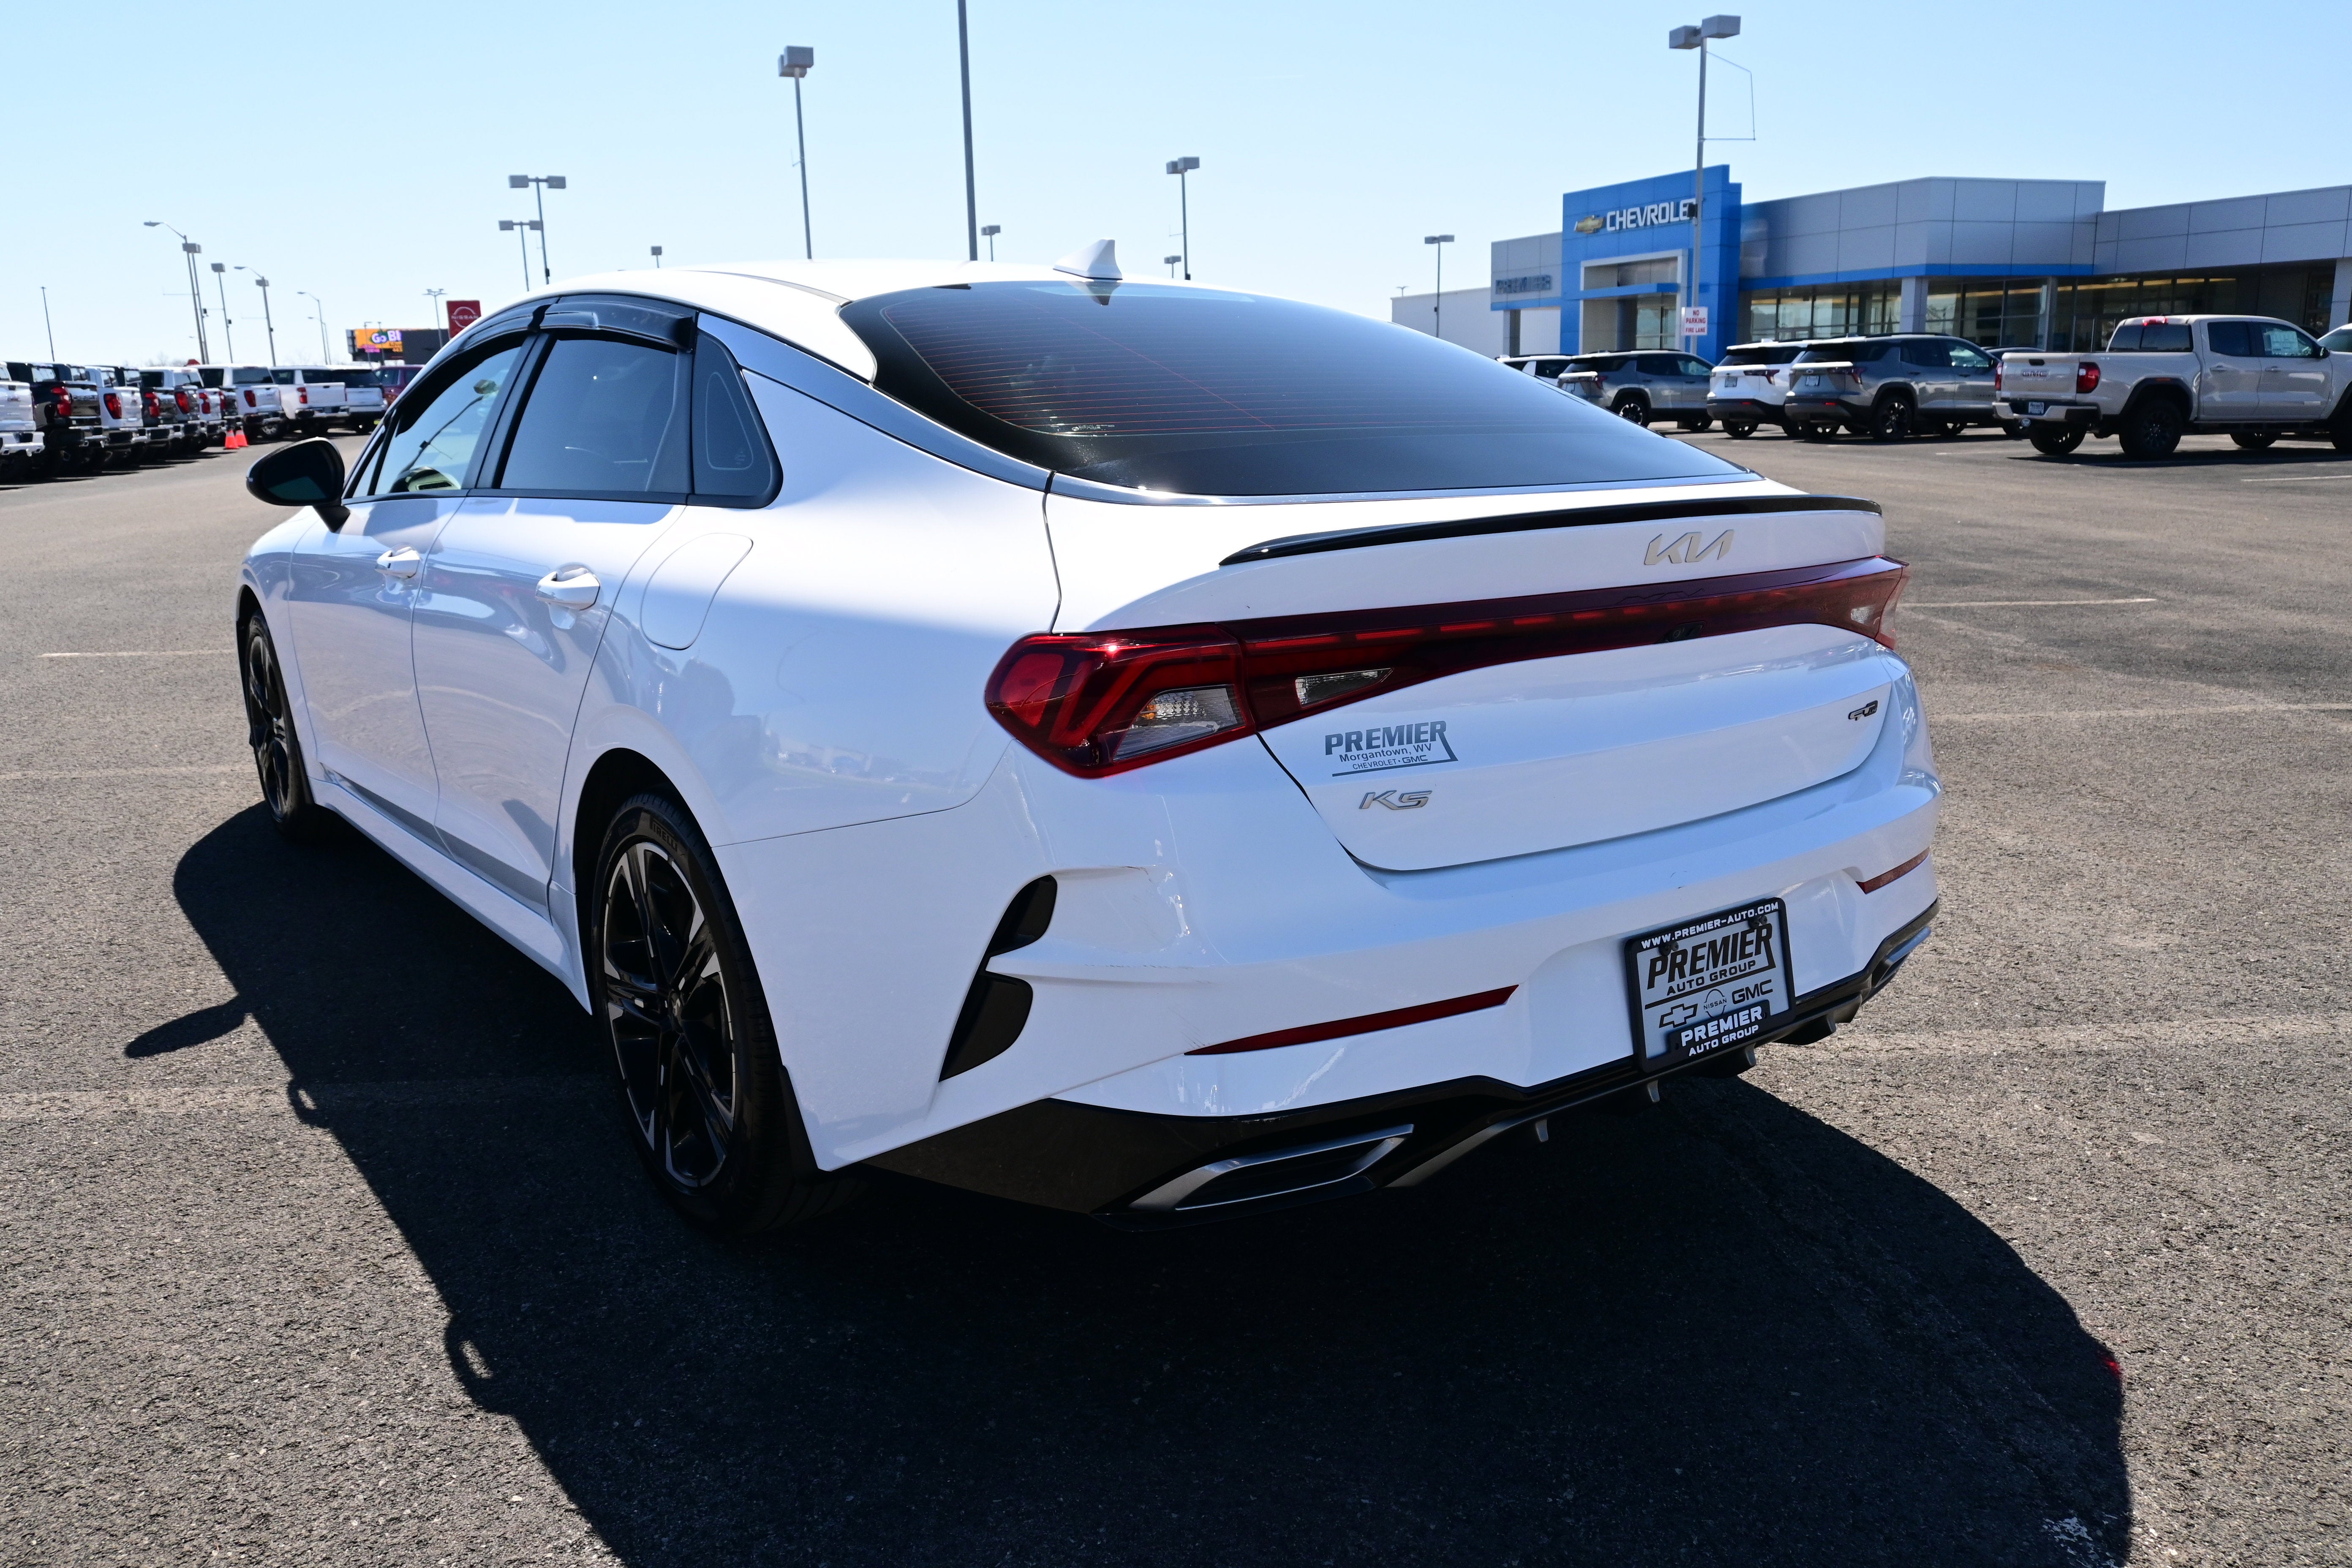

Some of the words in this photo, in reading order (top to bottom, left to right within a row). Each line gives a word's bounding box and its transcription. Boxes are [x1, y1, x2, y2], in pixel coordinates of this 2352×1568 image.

[371, 333, 387, 344] Go
[2022, 369, 2049, 377] GMC
[1644, 529, 1734, 565] KIA
[1325, 720, 1447, 755] PREMIER
[1339, 748, 1412, 762] Morgantown,
[1413, 743, 1432, 753] WV
[1352, 759, 1396, 770] CHEVROLET
[1402, 755, 1428, 764] GMC
[1359, 790, 1432, 810] K5
[649, 817, 678, 852] PIRELLI
[1641, 901, 1779, 949] WWW.PREMIER-AUTO.COM
[1647, 923, 1773, 990] PREMIER
[1666, 977, 1705, 996] AUTO
[1710, 960, 1756, 980] GROUP
[1703, 998, 1727, 1010] NISSAN
[1732, 979, 1773, 1004] GMC
[1681, 1006, 1762, 1047] PREMIER
[1689, 1038, 1719, 1057] AUTO
[1722, 1025, 1759, 1044] GROUP
